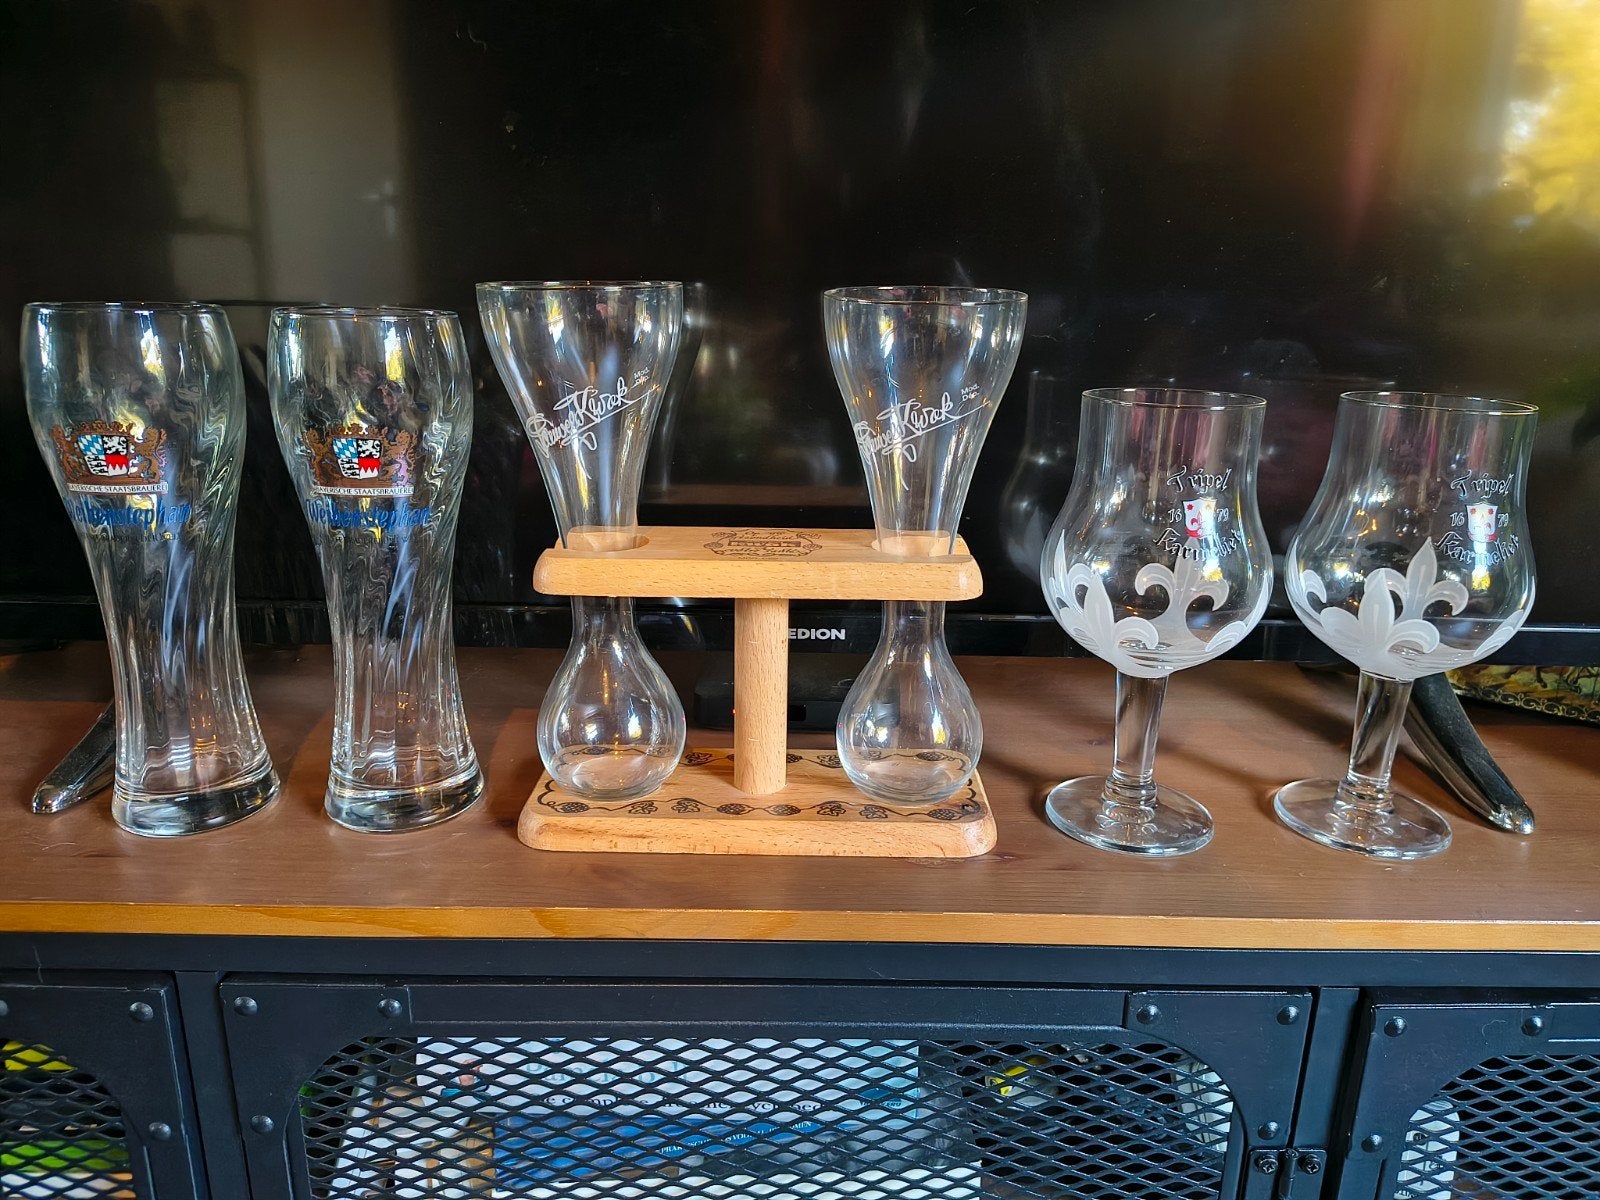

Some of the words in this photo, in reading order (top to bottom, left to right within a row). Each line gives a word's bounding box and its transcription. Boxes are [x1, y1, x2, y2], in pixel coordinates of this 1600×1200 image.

[553, 376, 632, 422] Kwak
[876, 391, 954, 436] Kwak
[1166, 464, 1233, 495] Tripel
[1450, 469, 1515, 499] Tripel
[788, 627, 846, 641] EDION
